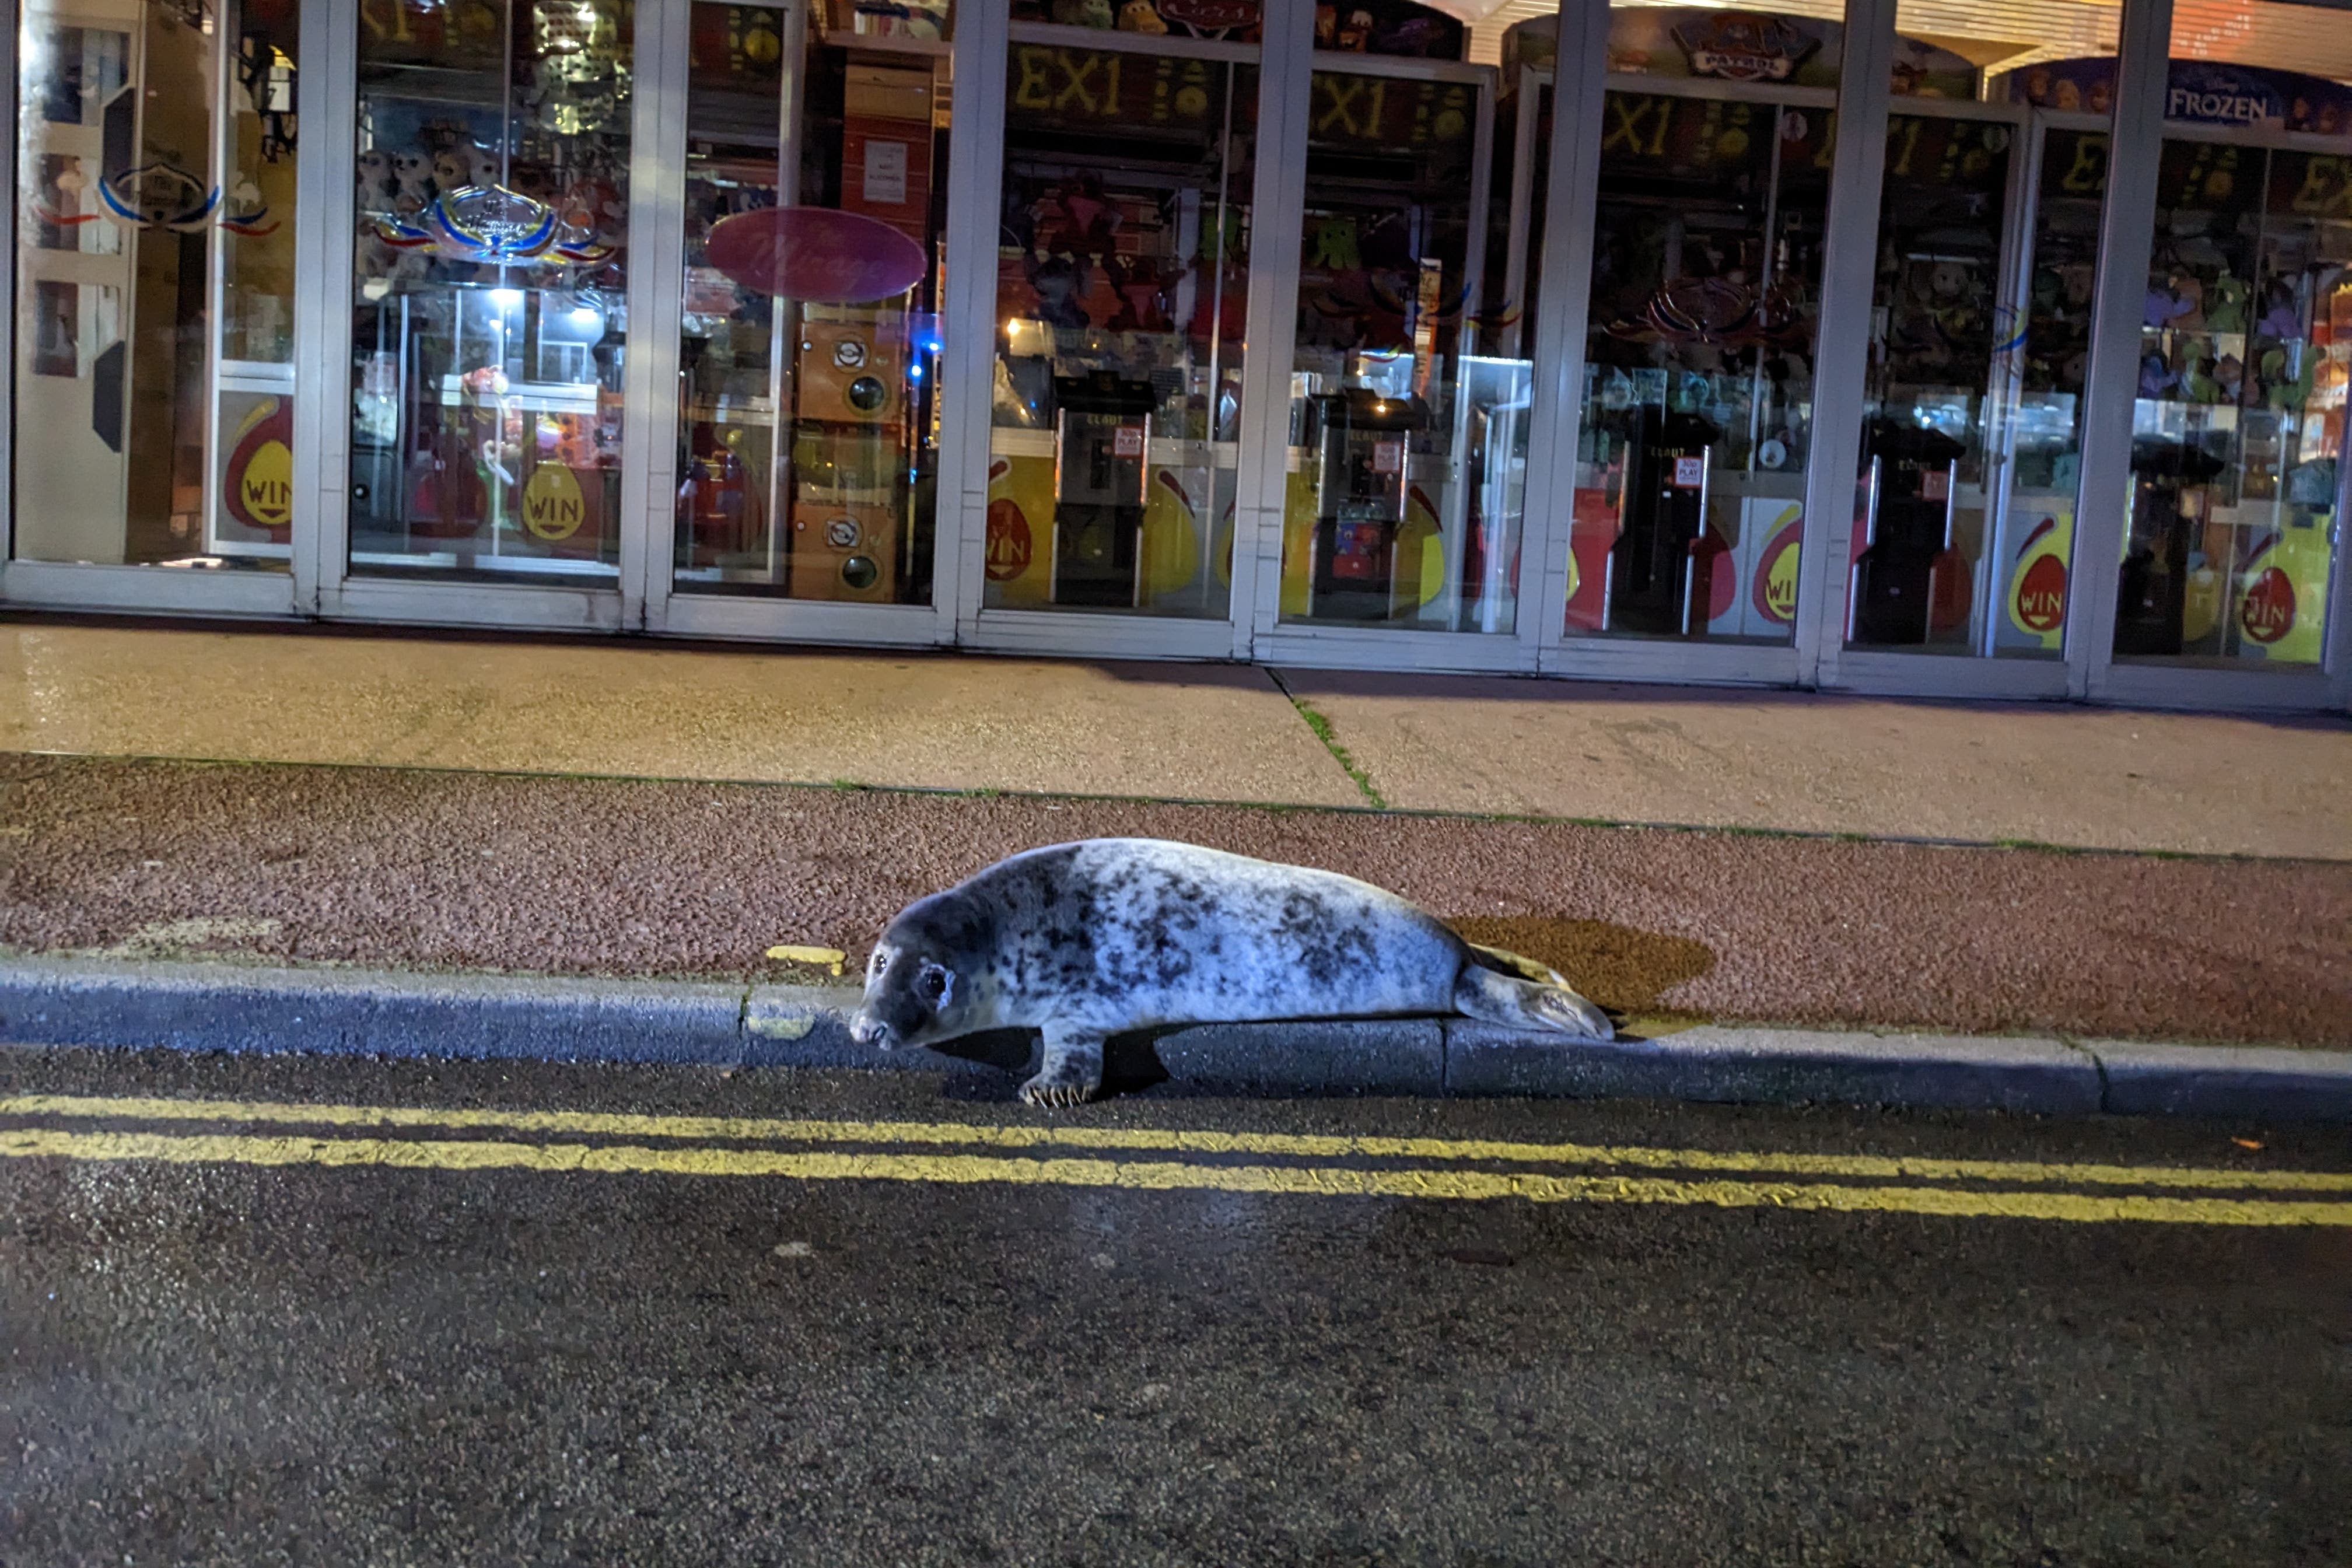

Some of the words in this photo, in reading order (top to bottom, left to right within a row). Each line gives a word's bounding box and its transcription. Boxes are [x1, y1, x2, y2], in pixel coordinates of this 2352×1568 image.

[2168, 88, 2267, 122] FROZEN
[1679, 468, 1698, 477] PLAY
[527, 496, 578, 522] WIN
[2021, 591, 2063, 614] WIN
